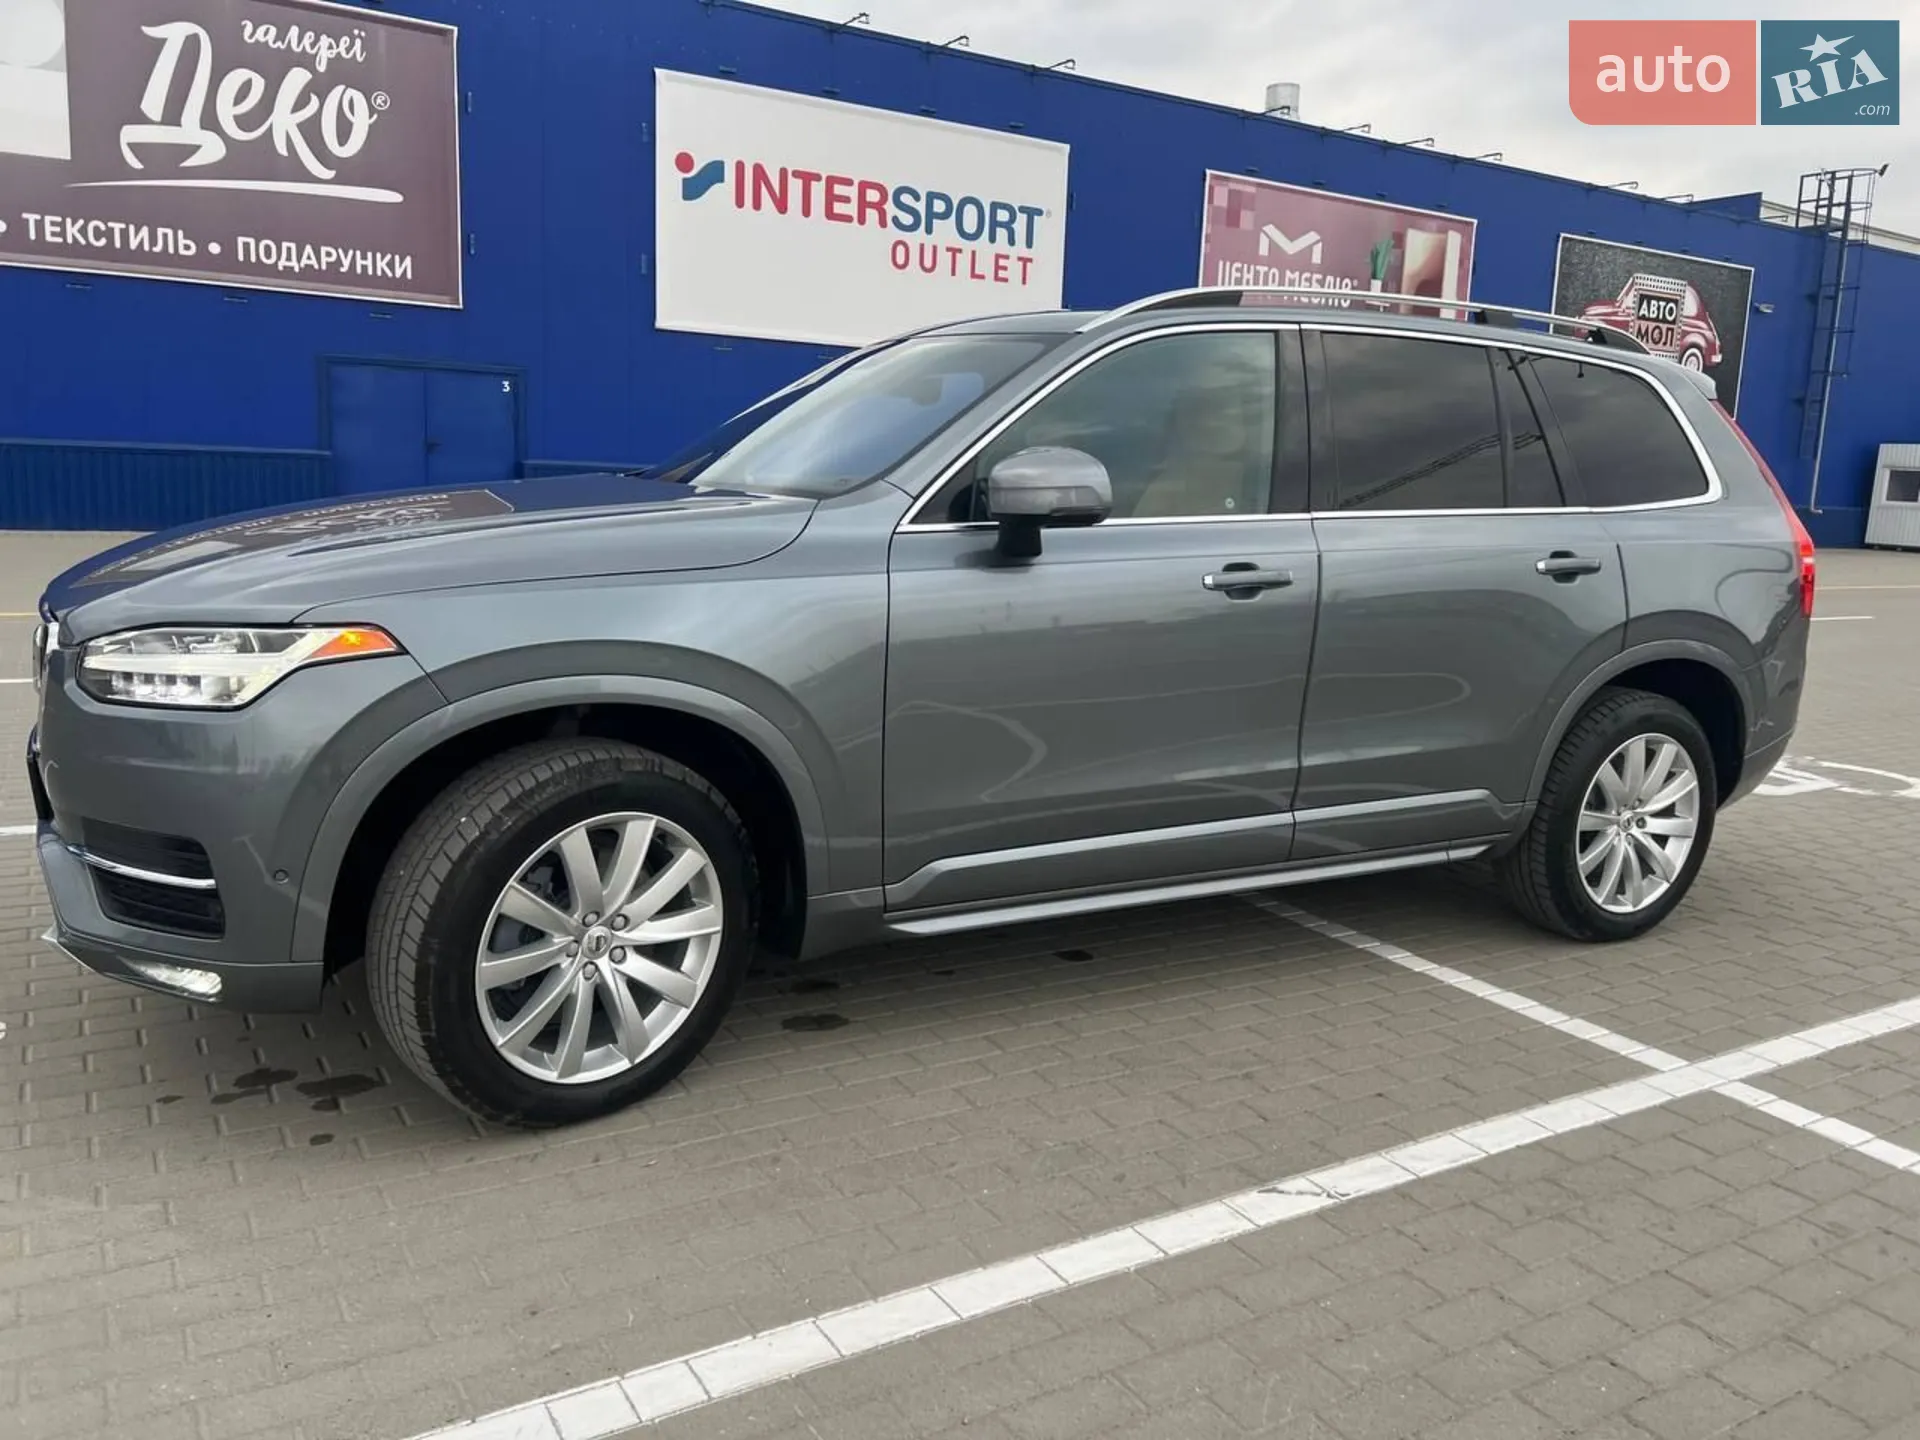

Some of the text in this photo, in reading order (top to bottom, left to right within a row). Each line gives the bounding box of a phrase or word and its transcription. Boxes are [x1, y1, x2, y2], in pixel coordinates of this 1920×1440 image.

[241, 19, 367, 73] галереї
[734, 160, 1044, 250] INTERSPORT
[21, 212, 412, 280] ТЕКСТИЛЬ ПОДАРУНКИ
[891, 239, 1033, 286] OUTLET
[1638, 299, 1677, 322] АВТО
[1636, 323, 1675, 347] МОЛ
[502, 380, 510, 392] 3
